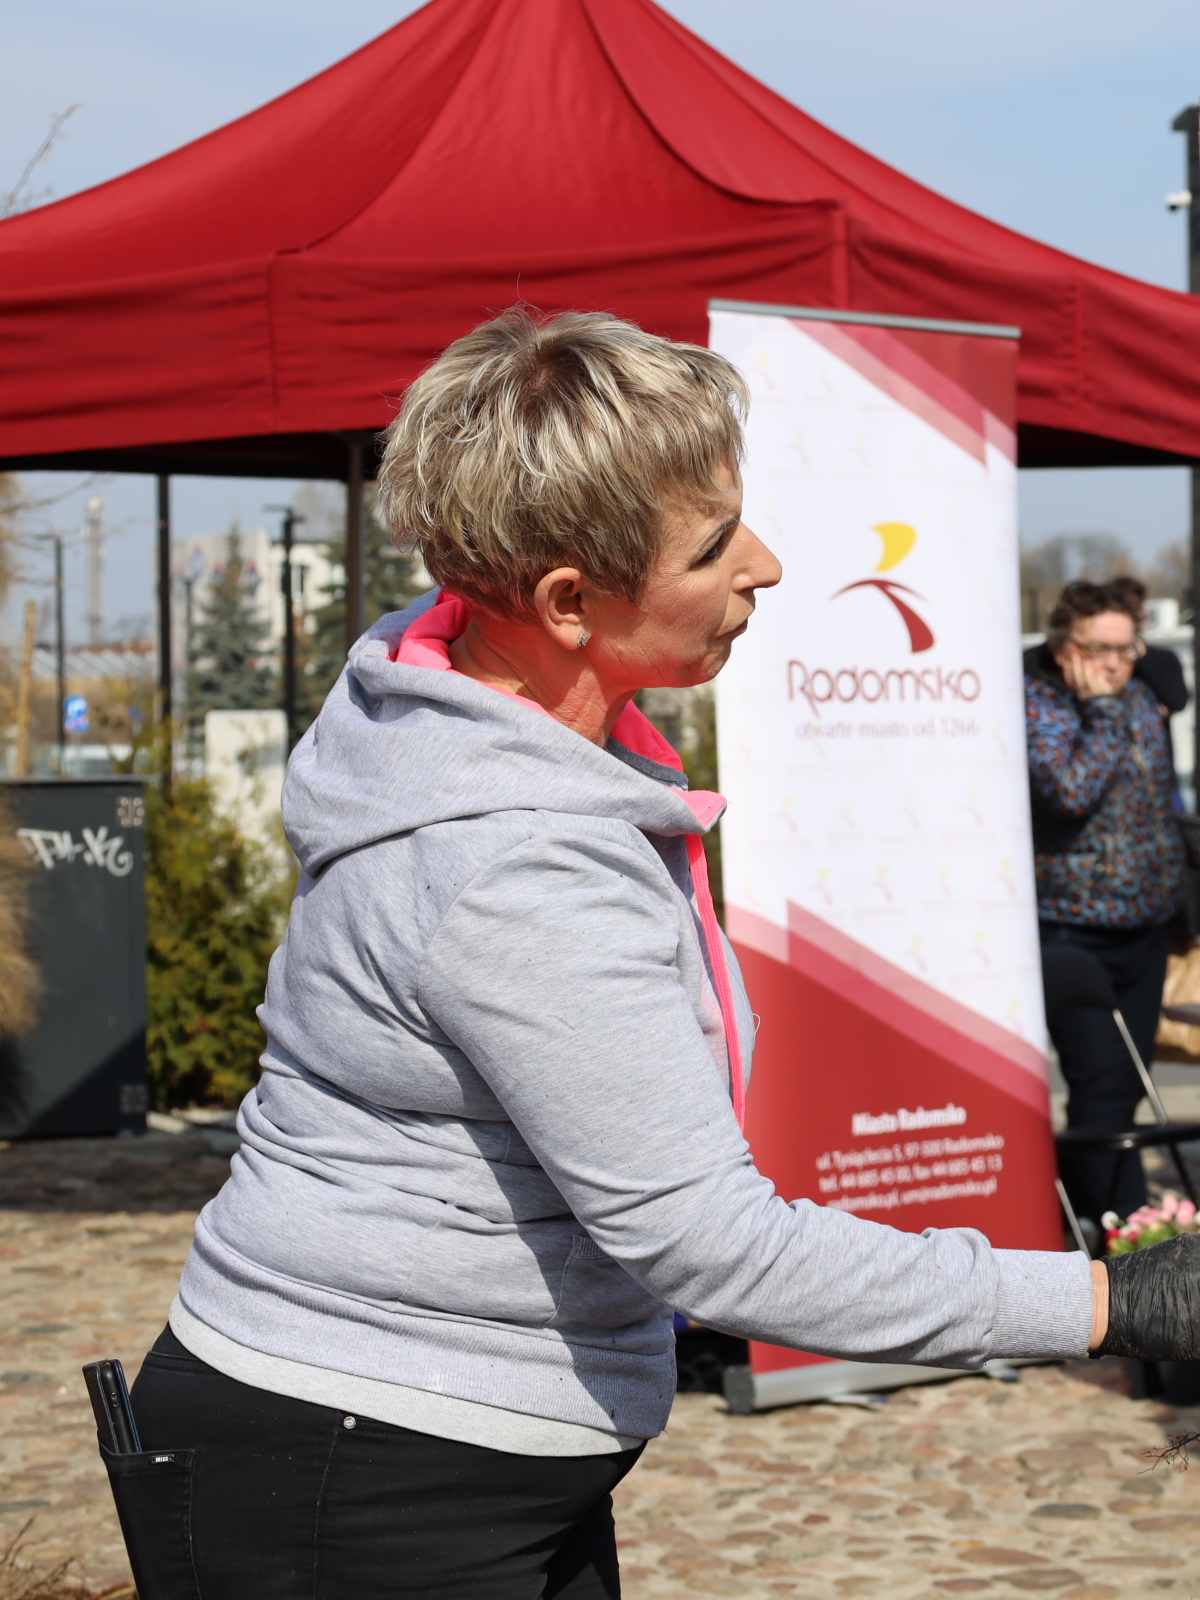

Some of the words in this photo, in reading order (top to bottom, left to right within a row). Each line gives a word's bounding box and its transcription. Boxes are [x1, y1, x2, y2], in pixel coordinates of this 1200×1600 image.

[787, 659, 982, 718] Radomsko
[859, 717, 910, 739] miasto
[914, 717, 936, 738] od
[941, 717, 980, 738] 1266
[897, 1102, 967, 1131] Radomsko
